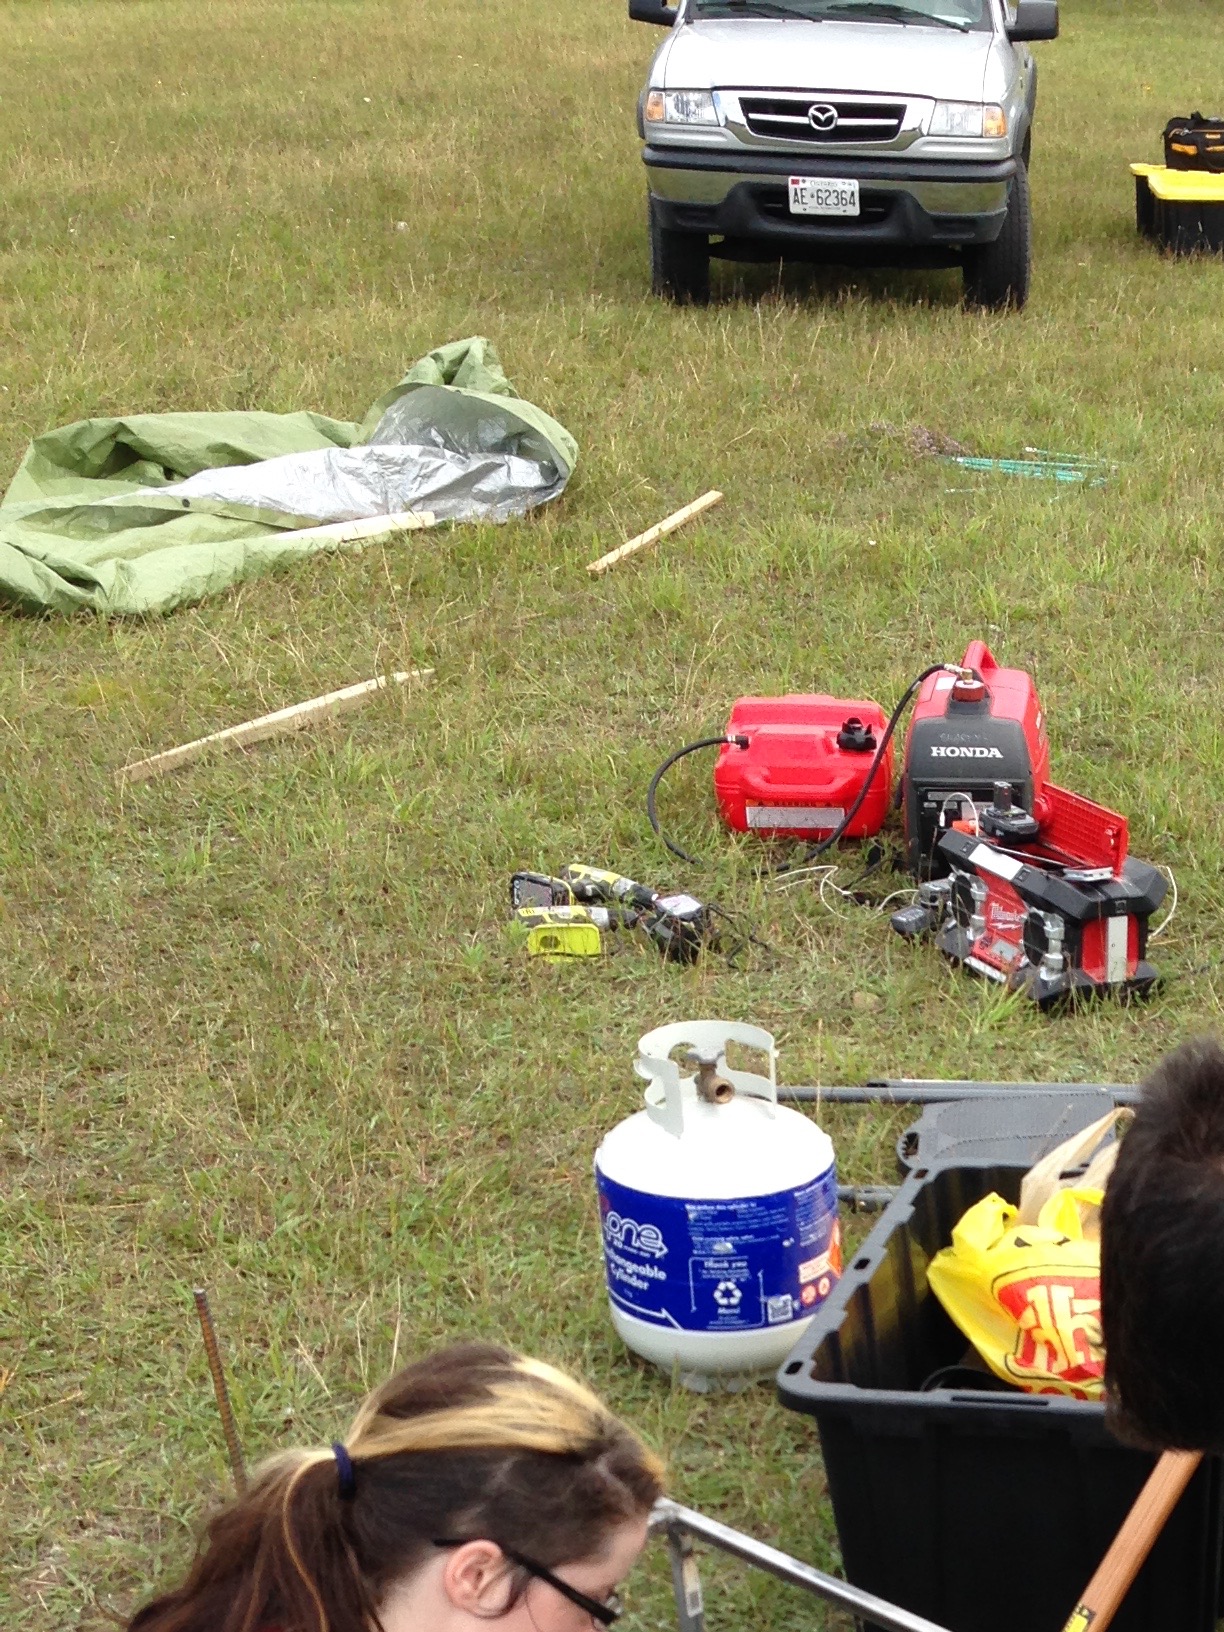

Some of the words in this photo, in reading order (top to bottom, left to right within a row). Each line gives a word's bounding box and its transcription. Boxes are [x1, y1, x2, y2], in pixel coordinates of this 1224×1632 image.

[793, 188, 808, 205] AE
[816, 189, 856, 207] 62364
[930, 746, 1004, 758] HONDA
